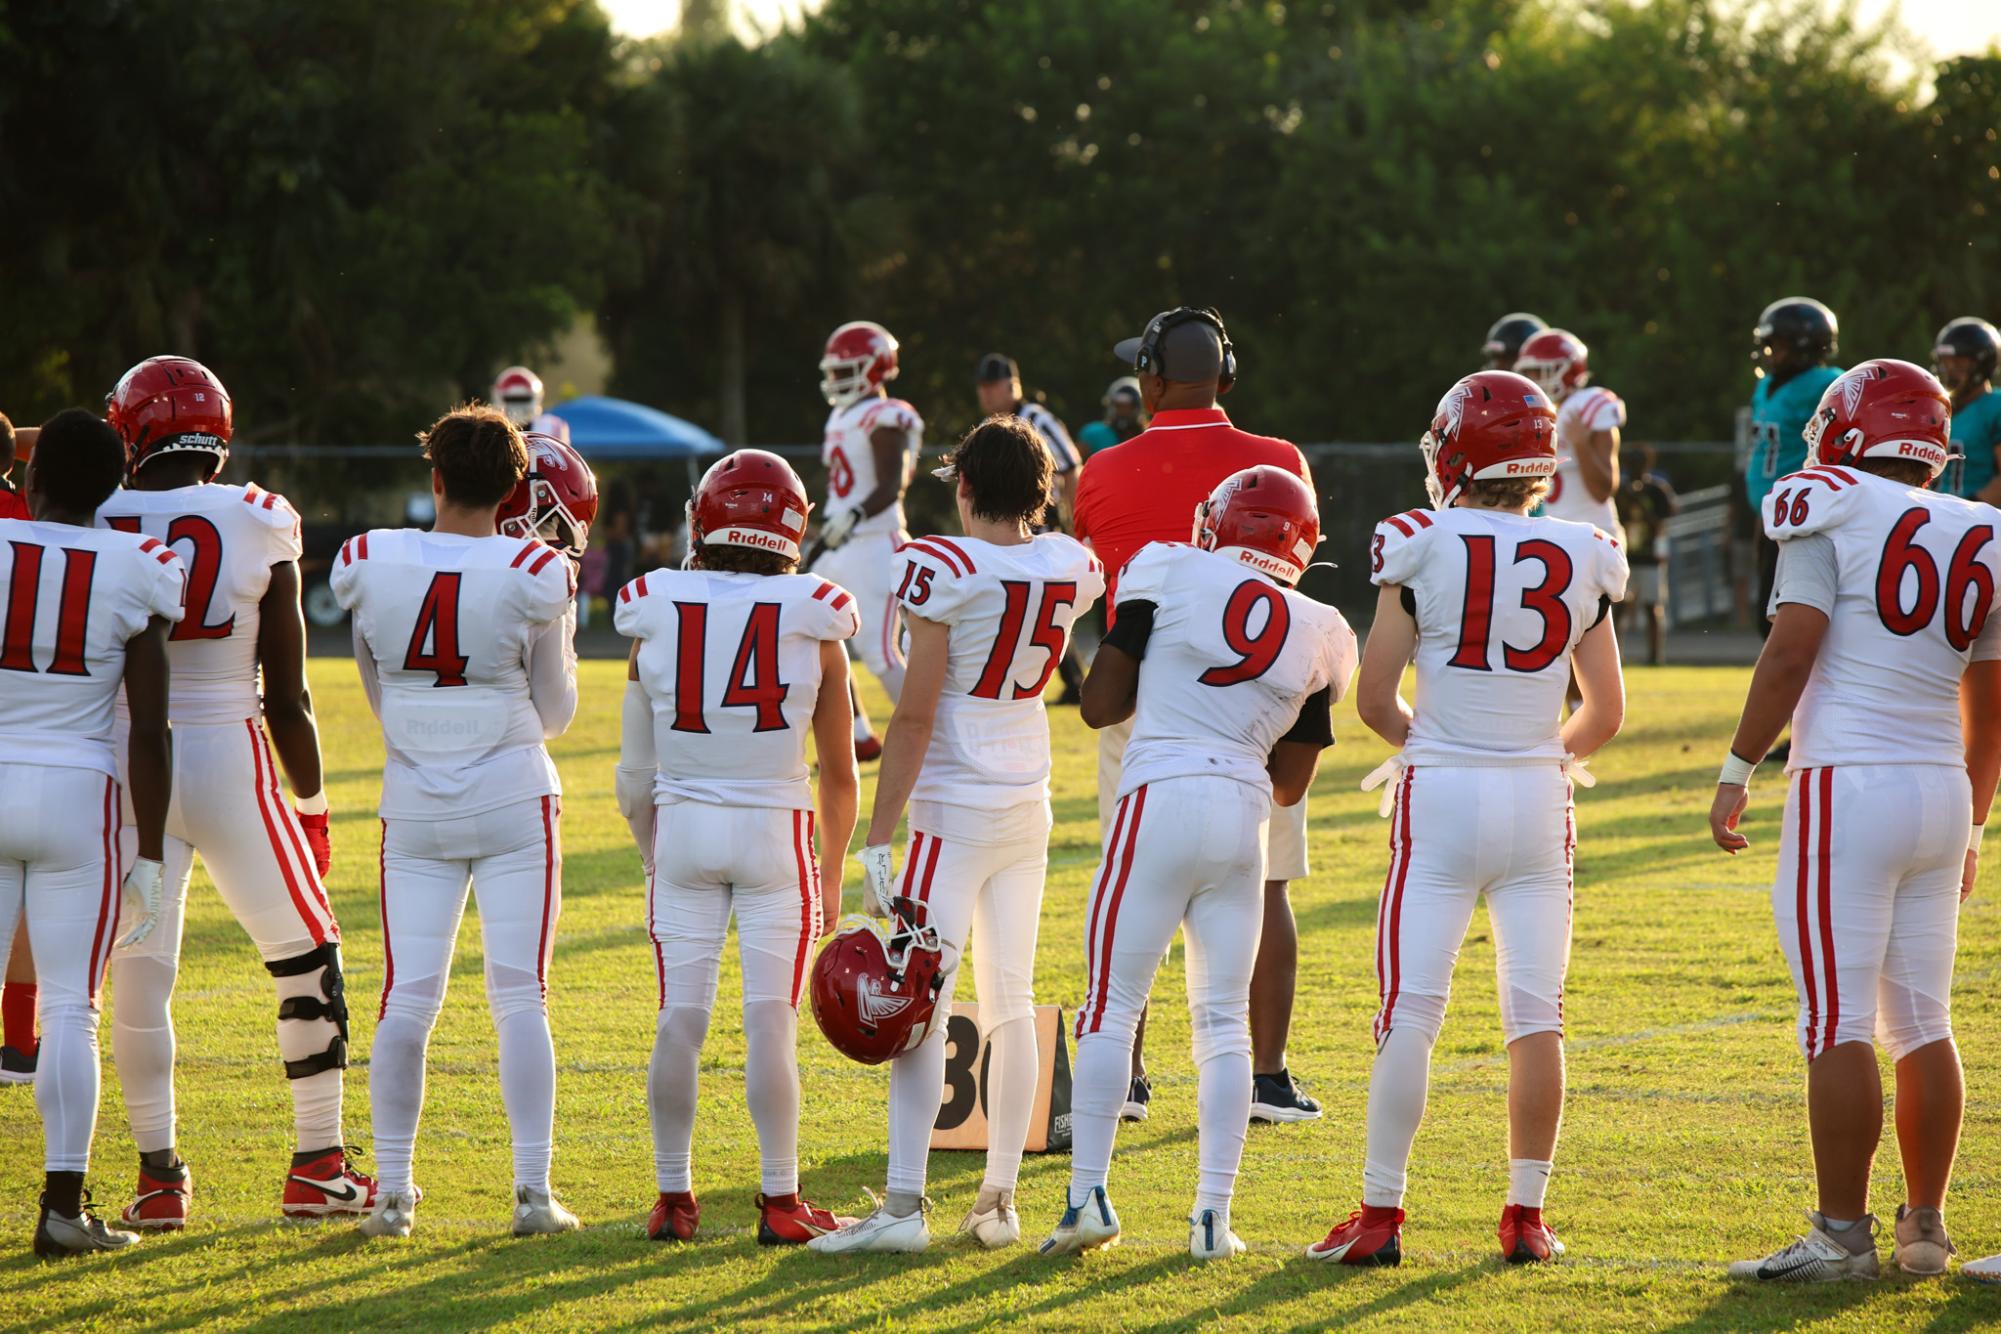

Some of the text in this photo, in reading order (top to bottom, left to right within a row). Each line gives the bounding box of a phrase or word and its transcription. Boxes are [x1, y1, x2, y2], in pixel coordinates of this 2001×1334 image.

[194, 393, 205, 402] 12
[1534, 419, 1543, 429] 13
[179, 432, 218, 446] schutt
[1506, 462, 1556, 474] Riddell
[762, 492, 773, 503] 14
[1773, 487, 1812, 528] 66
[104, 514, 236, 642] 2
[728, 530, 787, 552] Riddell
[1239, 550, 1295, 578] Riddell
[1875, 506, 1995, 653] 66
[0, 540, 98, 677] 11
[896, 559, 936, 606] 15
[1446, 533, 1573, 673] 13
[402, 570, 470, 688] 4
[670, 600, 791, 735] 14
[967, 579, 1077, 701] 15
[1196, 578, 1291, 688] 9
[933, 1014, 992, 1131] 3
